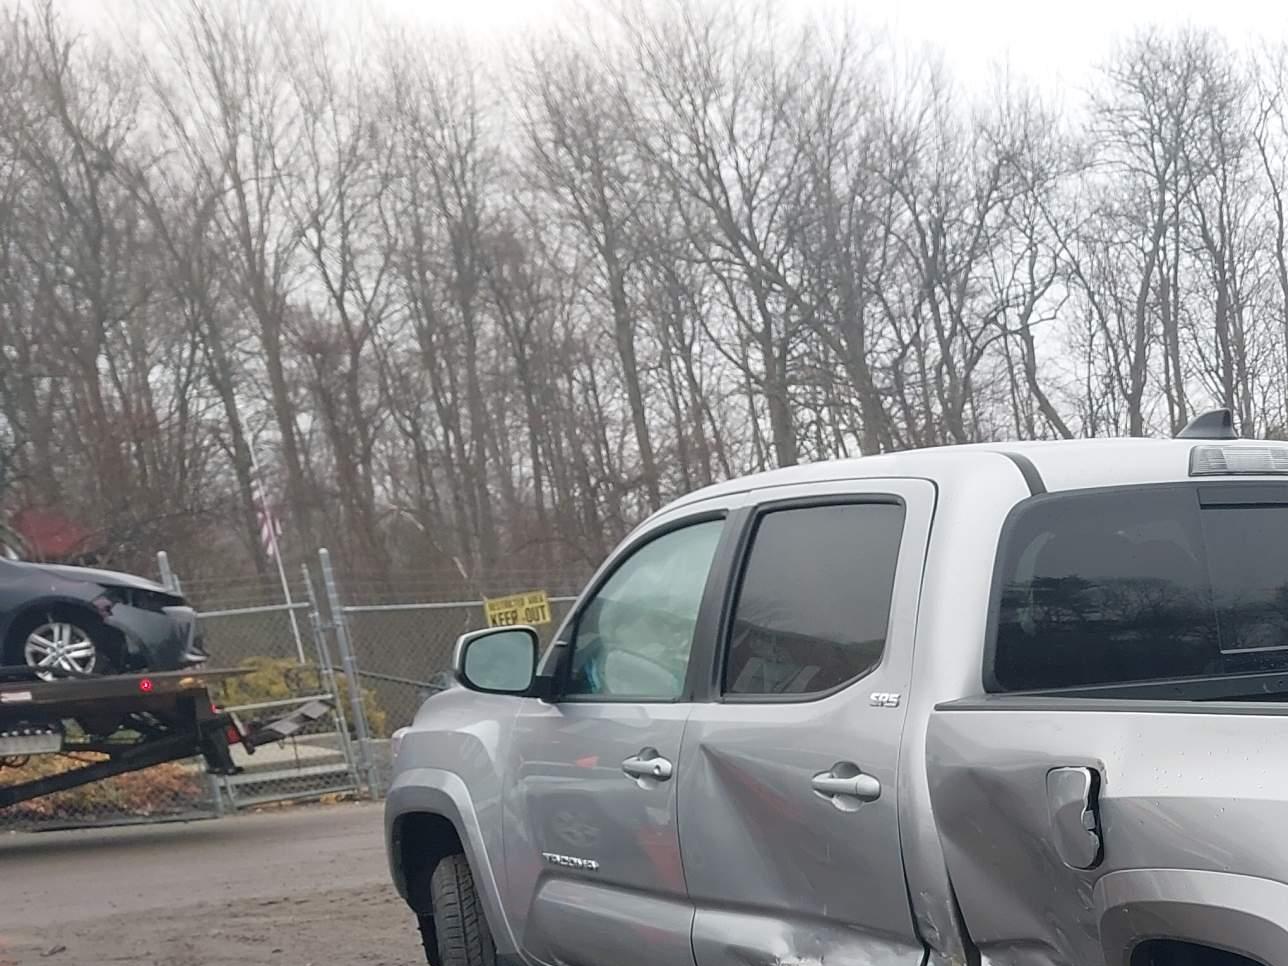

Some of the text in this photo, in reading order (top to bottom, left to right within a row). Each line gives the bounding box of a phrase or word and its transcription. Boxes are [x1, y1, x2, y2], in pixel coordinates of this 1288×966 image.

[490, 604, 546, 625] KEEP OUT
[870, 692, 901, 708] SR5
[542, 852, 599, 869] TACOMA
